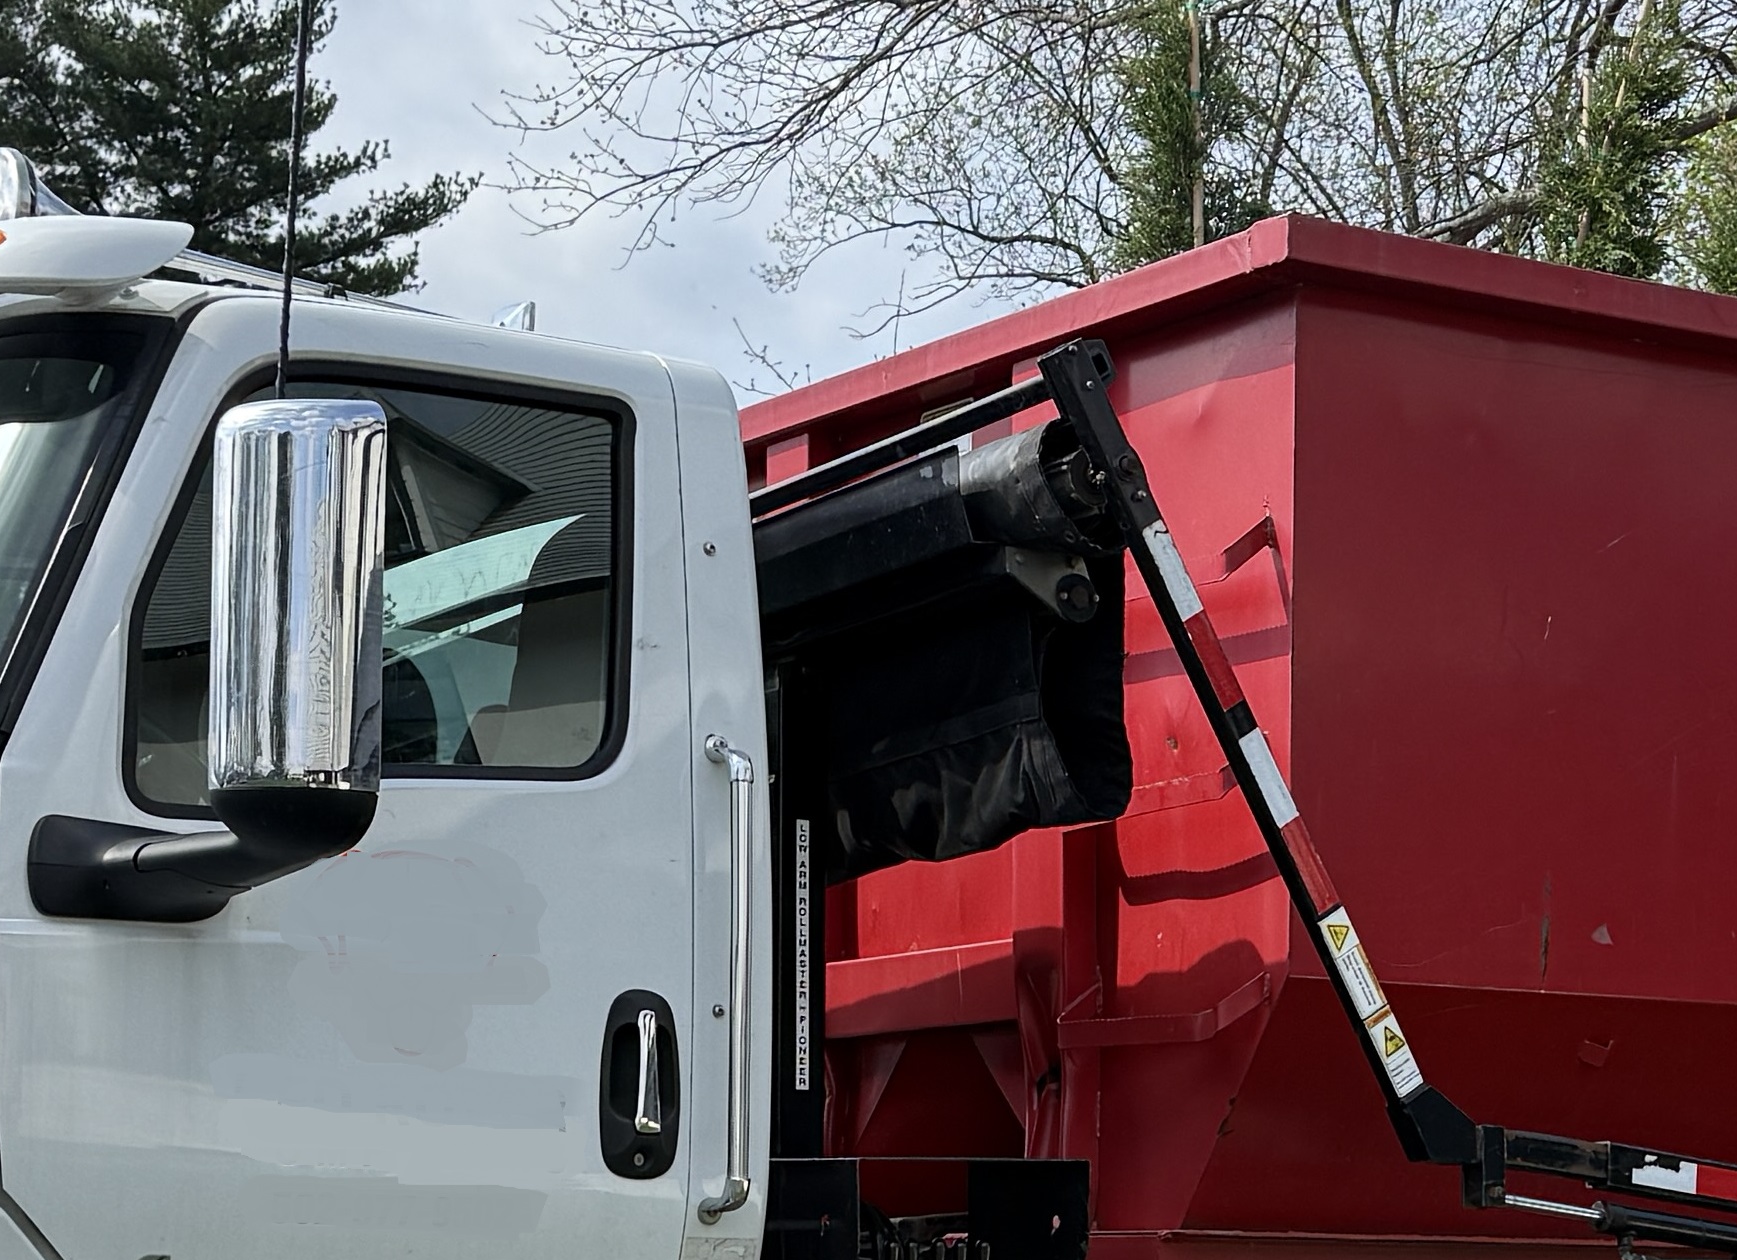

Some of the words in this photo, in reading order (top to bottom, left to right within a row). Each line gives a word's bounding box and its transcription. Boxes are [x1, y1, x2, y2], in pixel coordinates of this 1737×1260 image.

[798, 824, 807, 853] LOW
[798, 860, 807, 890] ARM
[798, 897, 807, 1000] ROLLMASTER
[798, 1015, 807, 1086] PIONEER
